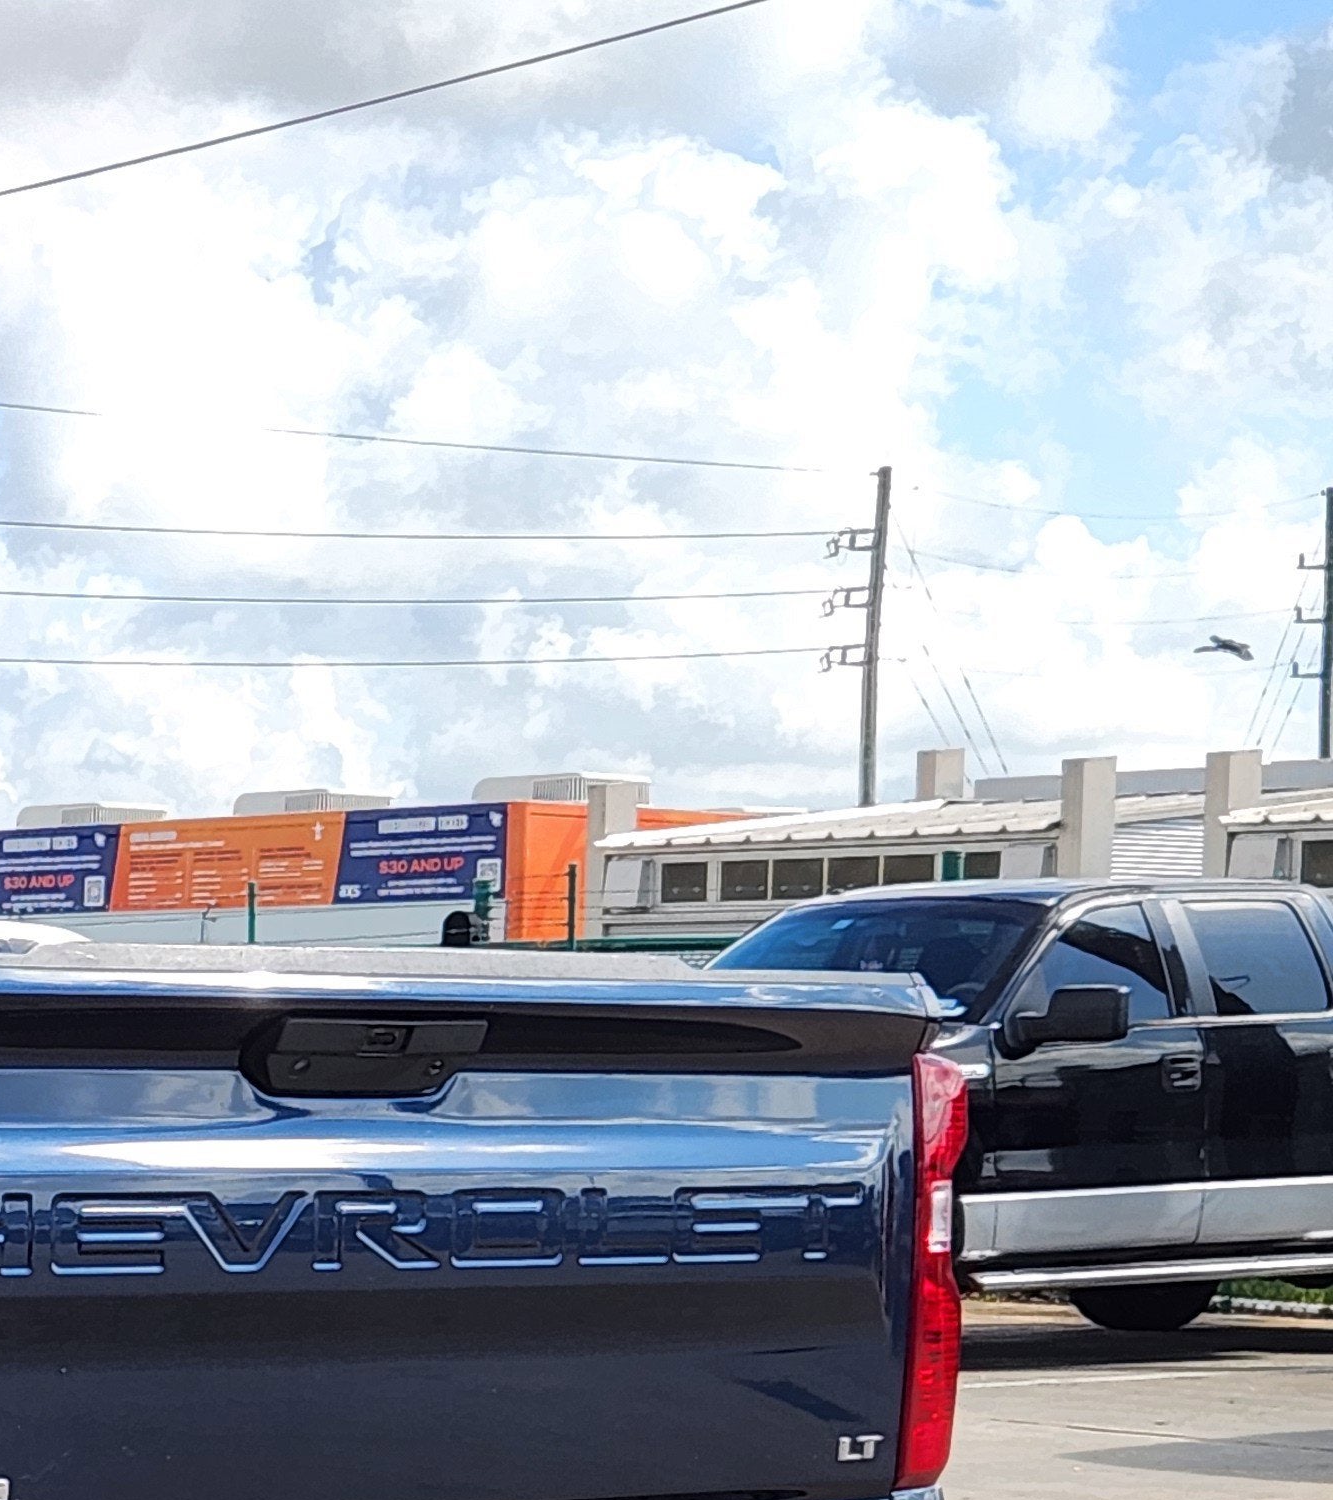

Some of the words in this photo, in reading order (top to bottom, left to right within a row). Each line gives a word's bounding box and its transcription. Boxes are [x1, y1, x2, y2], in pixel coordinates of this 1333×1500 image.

[378, 860, 408, 875] $30
[410, 857, 441, 873] AND
[443, 856, 465, 871] UP
[29, 874, 55, 889] AND
[57, 874, 74, 888] UP
[838, 1435, 884, 1461] LT
